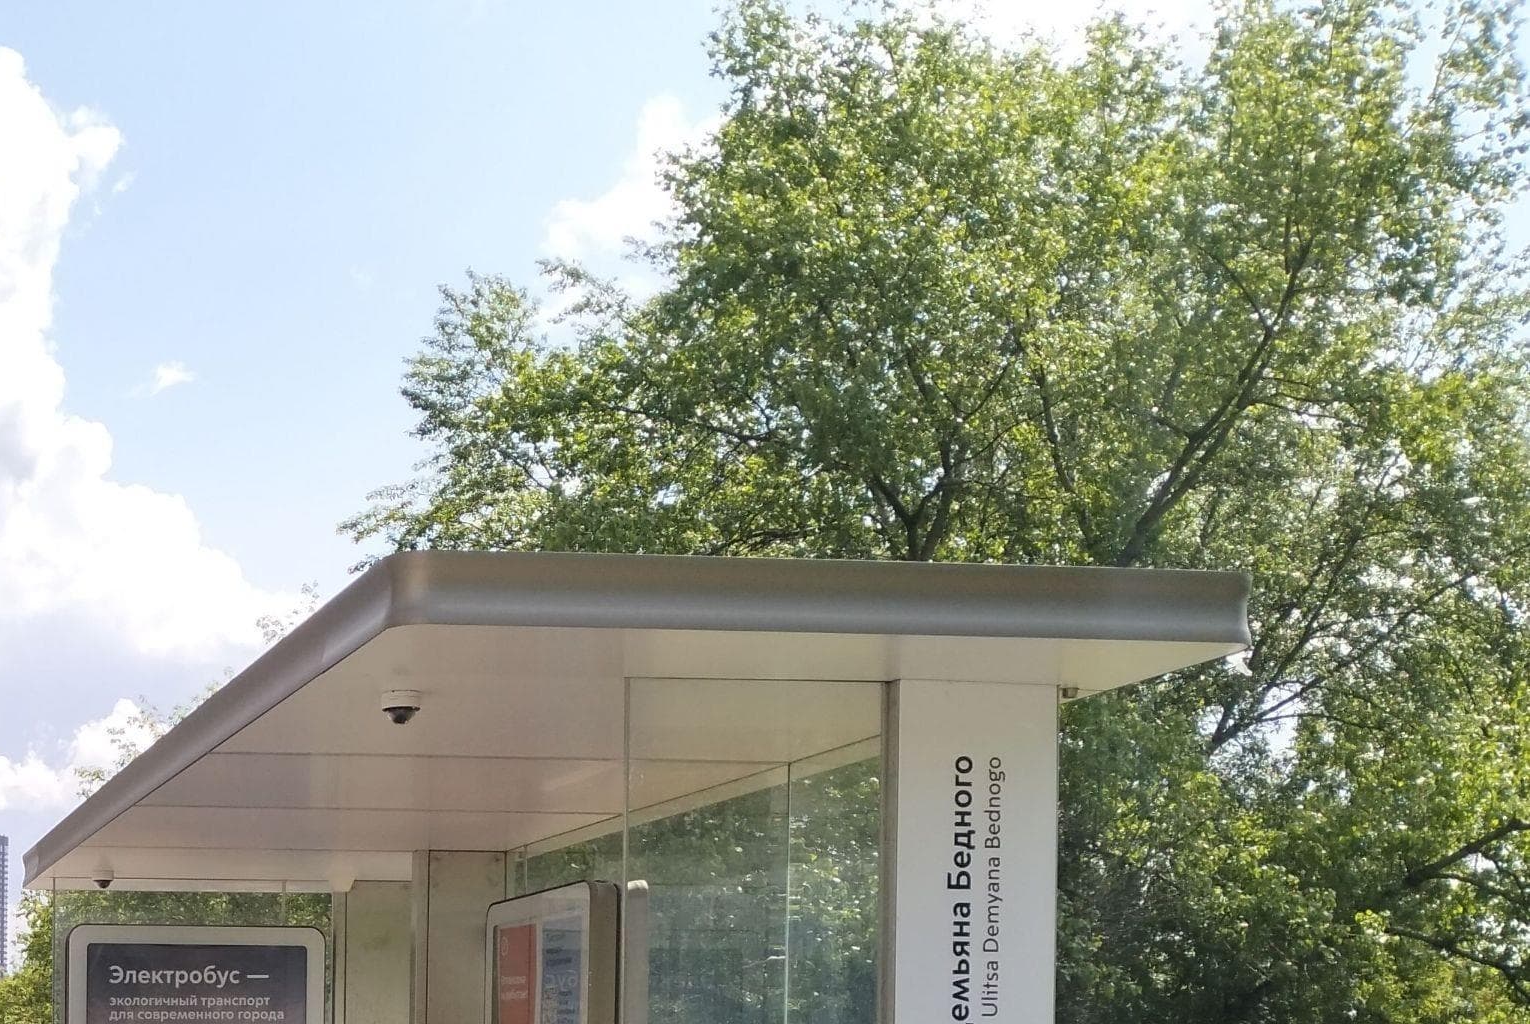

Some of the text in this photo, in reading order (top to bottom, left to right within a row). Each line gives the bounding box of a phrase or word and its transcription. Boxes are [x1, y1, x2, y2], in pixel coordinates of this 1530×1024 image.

[947, 755, 976, 890] Бедного
[981, 756, 1006, 1017] Ulitsa Demyana Bednogo
[109, 965, 240, 989] Электробус
[109, 995, 271, 1009] экологичный транспорт
[109, 1010, 285, 1022] для современного города
